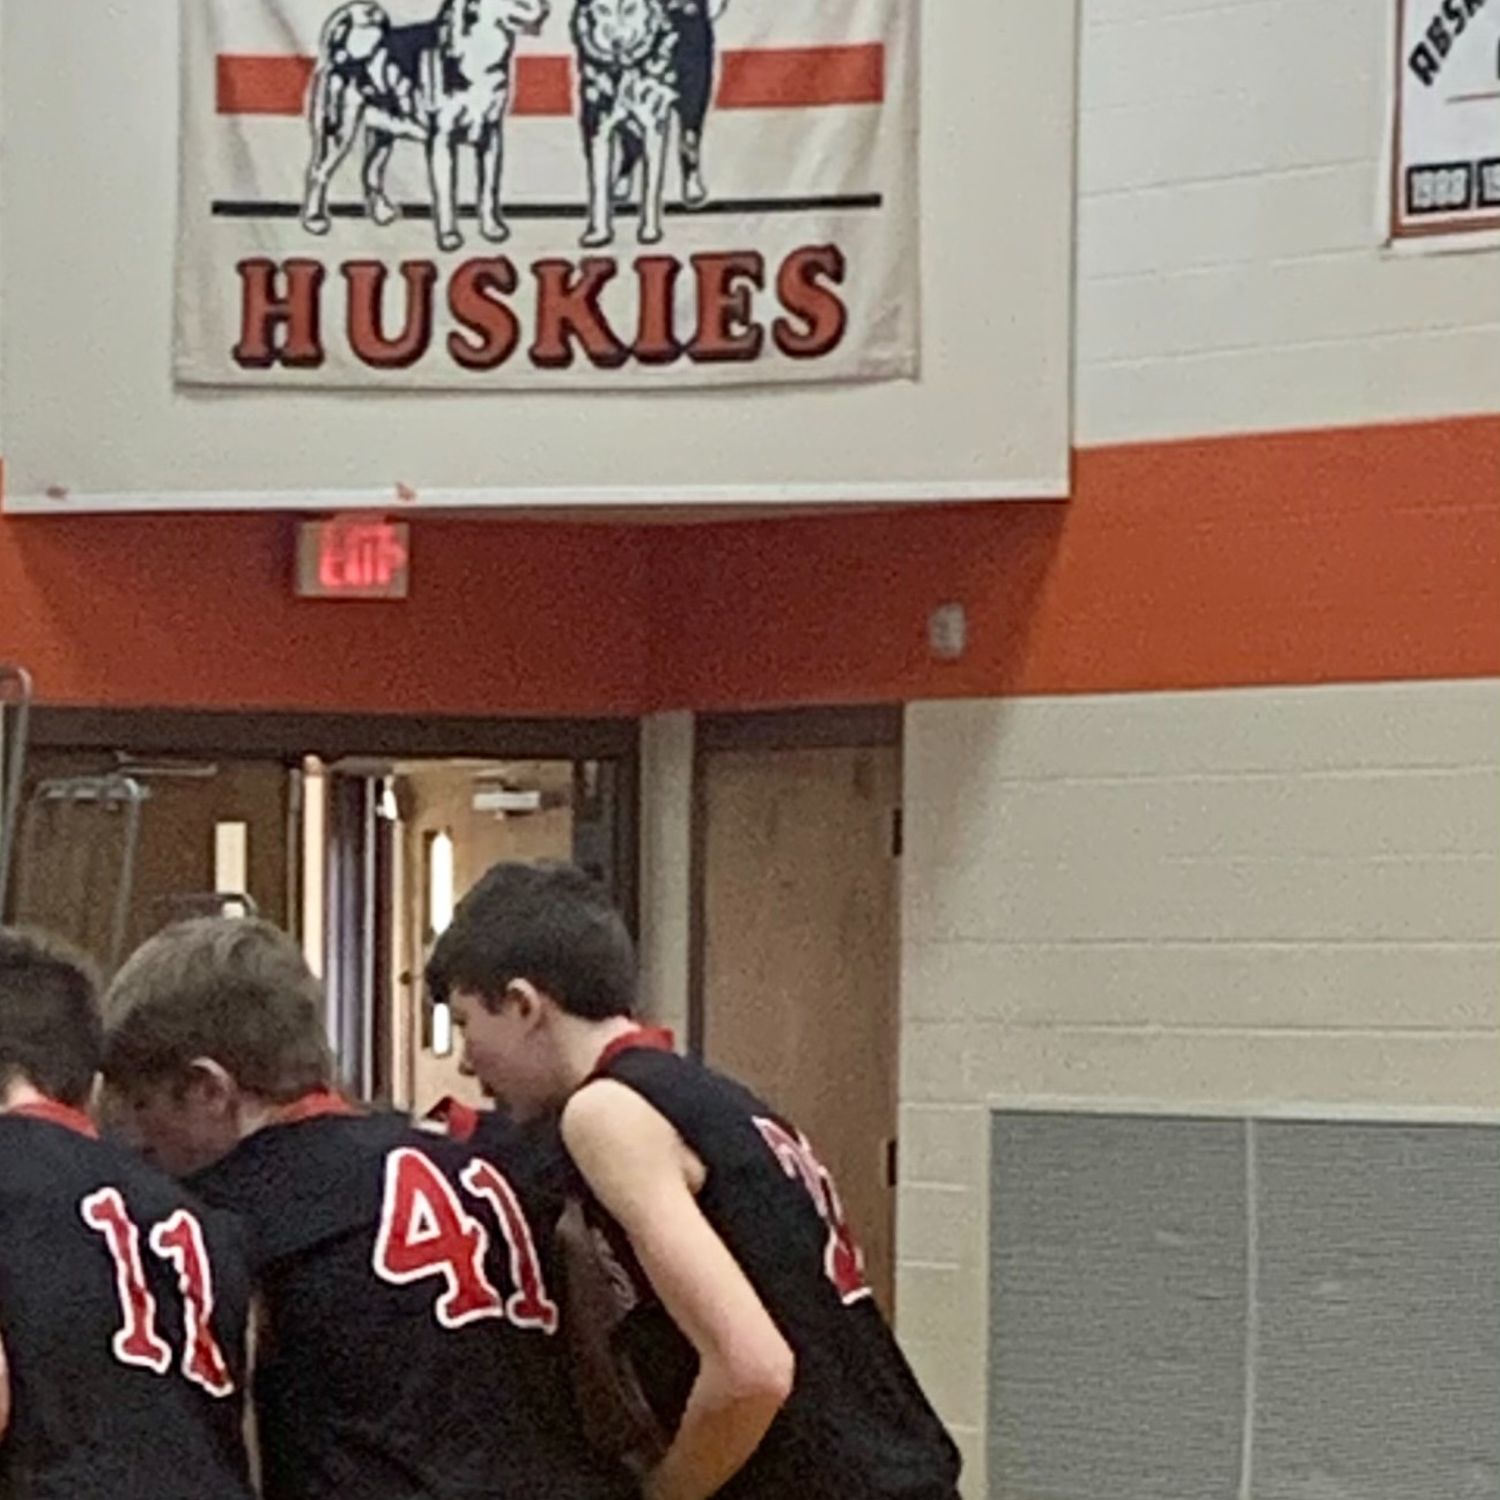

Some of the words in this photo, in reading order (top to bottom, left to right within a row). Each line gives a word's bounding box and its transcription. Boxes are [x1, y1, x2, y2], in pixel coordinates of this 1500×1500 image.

[232, 243, 847, 369] HUSKIES
[82, 1186, 234, 1398] 11
[373, 1146, 557, 1335] 41
